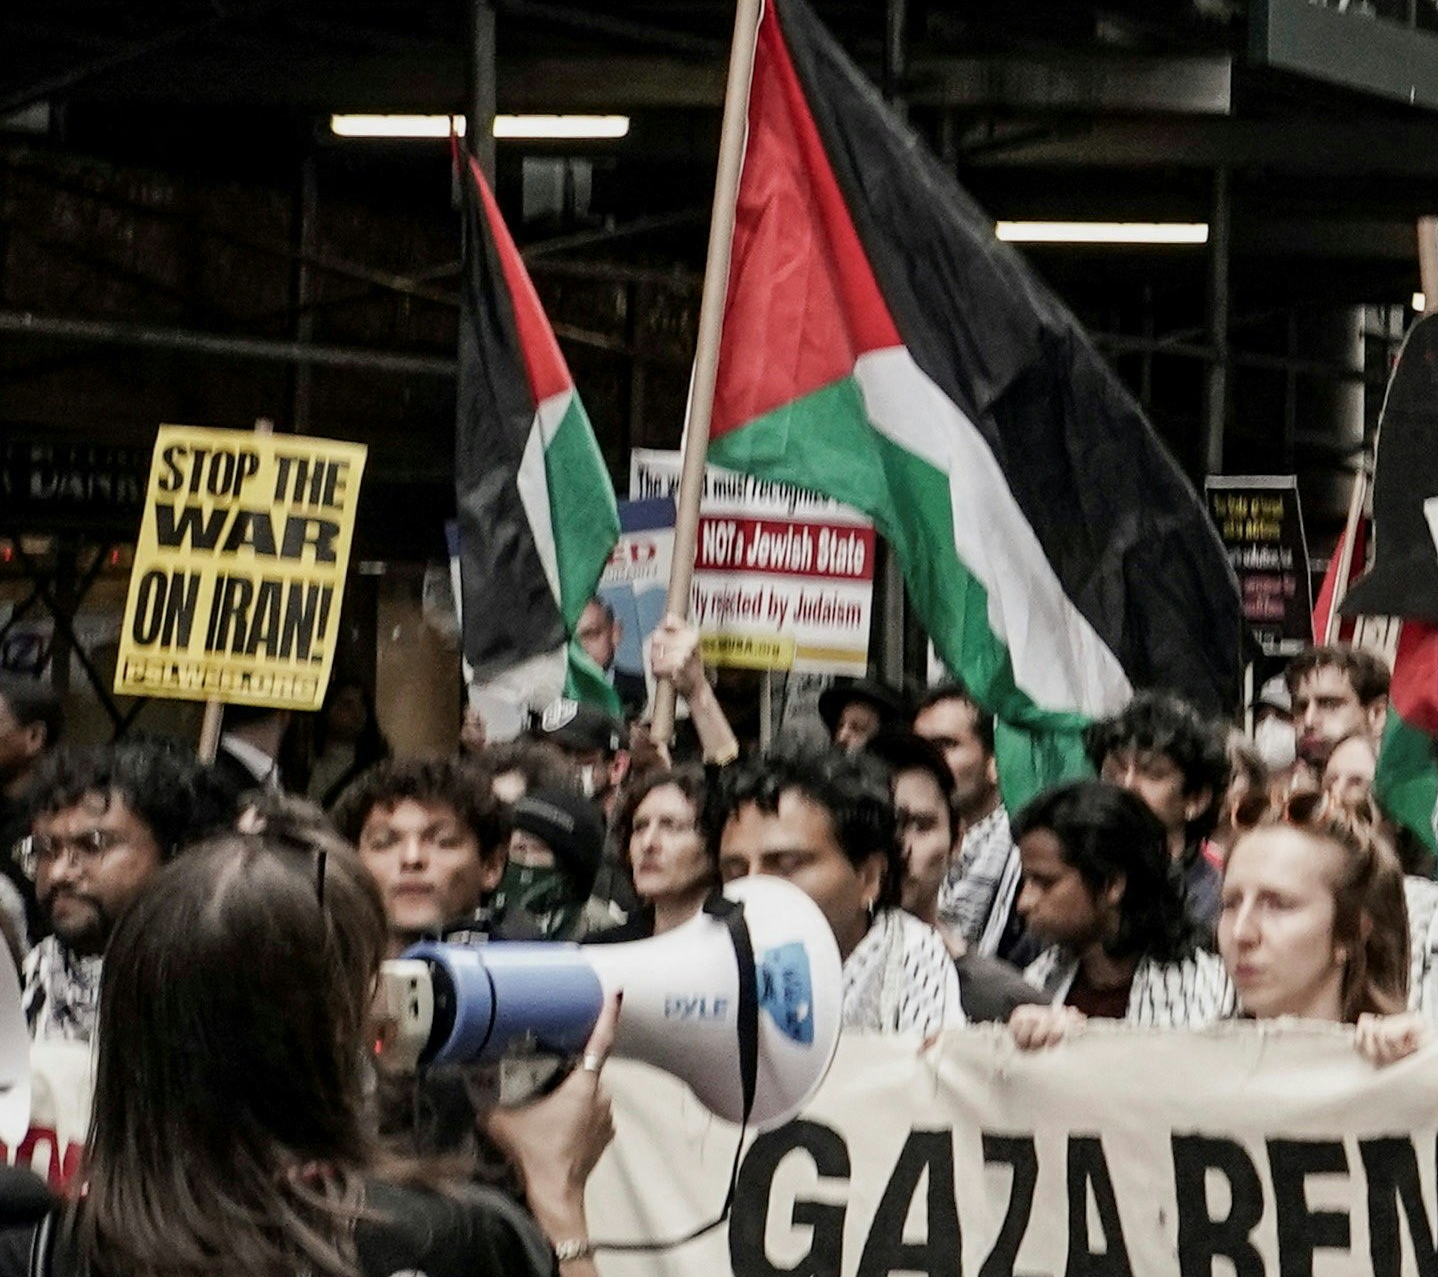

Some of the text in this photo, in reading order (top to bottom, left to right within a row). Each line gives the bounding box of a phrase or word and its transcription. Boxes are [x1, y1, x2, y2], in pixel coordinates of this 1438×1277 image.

[158, 441, 351, 513] STOP THE
[155, 503, 342, 567] WAR
[702, 520, 736, 565] NOT
[746, 522, 814, 572] Jewish
[815, 526, 866, 577] State
[132, 568, 333, 665] ON IRAN!
[767, 586, 790, 632] by
[793, 588, 863, 630] Judaism
